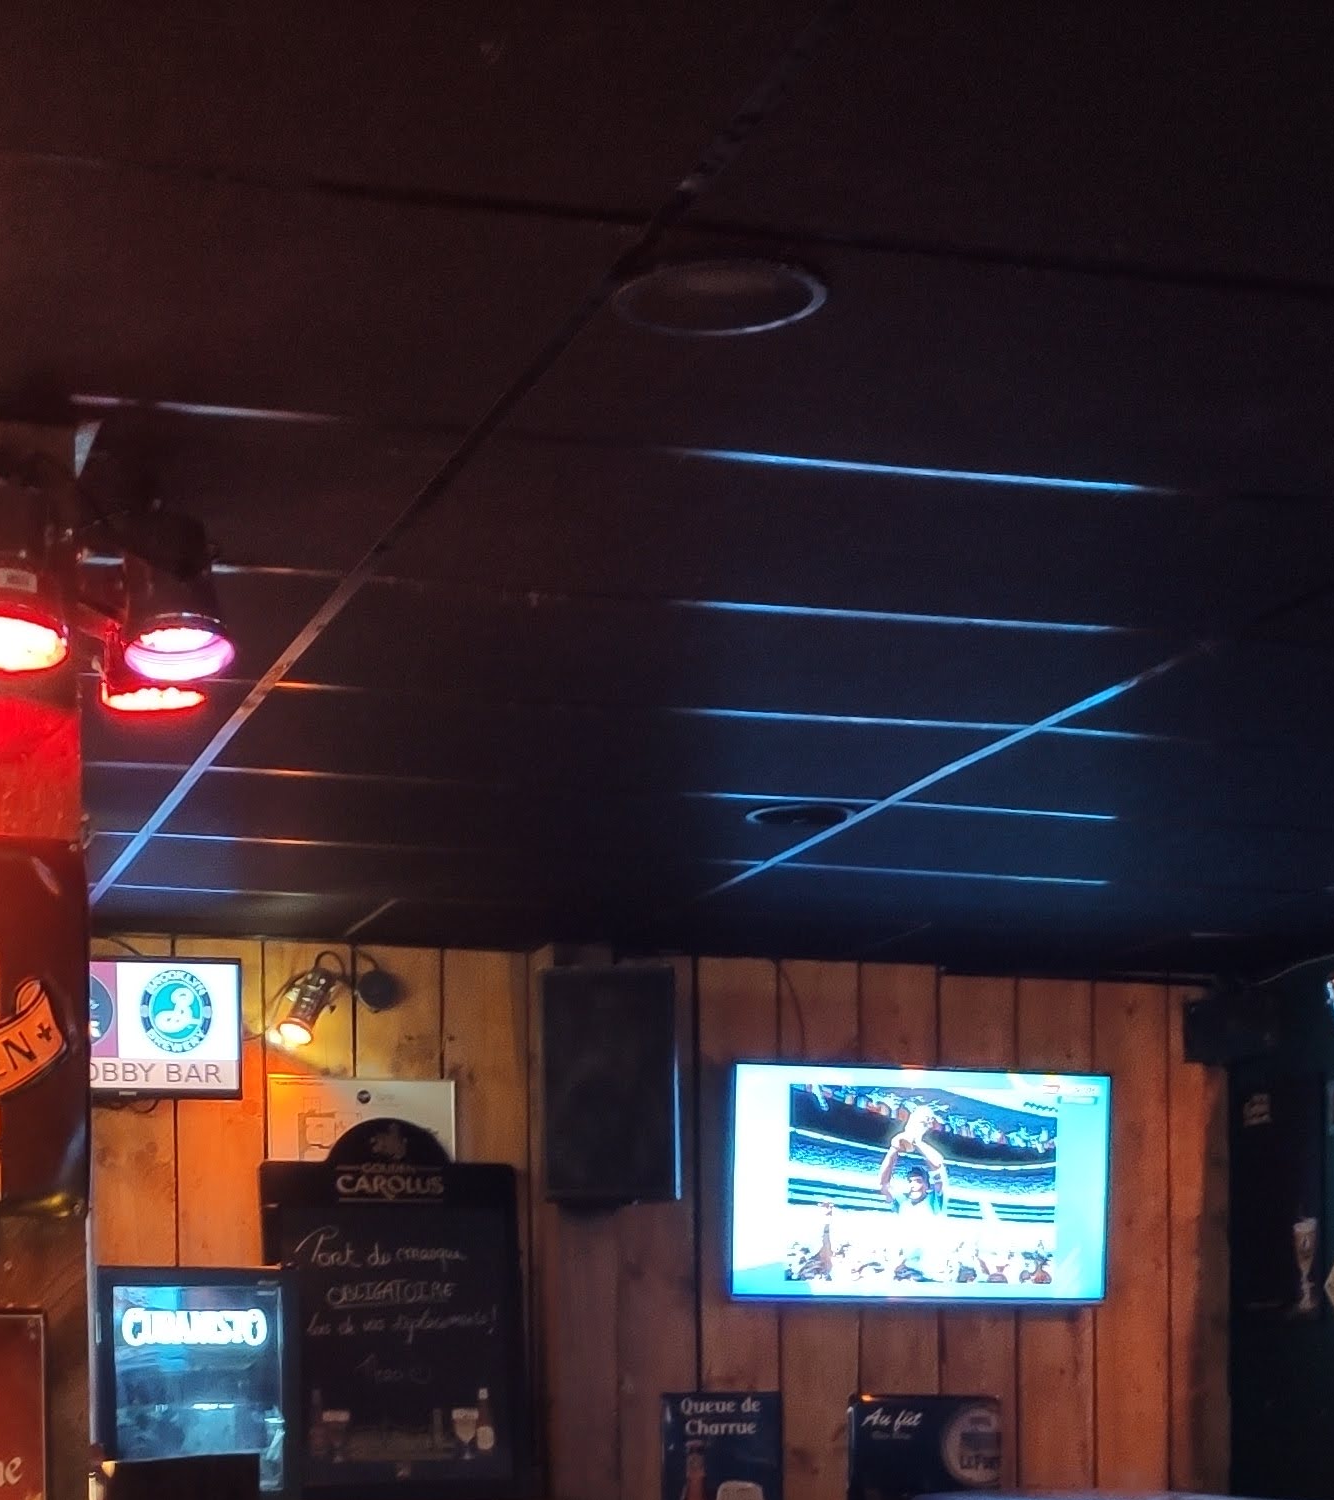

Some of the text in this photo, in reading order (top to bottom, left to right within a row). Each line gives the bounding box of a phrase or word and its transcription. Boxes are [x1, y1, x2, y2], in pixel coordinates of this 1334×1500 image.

[90, 1062, 222, 1084] OBBY BAR
[336, 1174, 445, 1200] CAROLUS
[680, 1396, 762, 1415] Queue de
[861, 1408, 892, 1427] Au
[684, 1419, 757, 1436] Charrue
